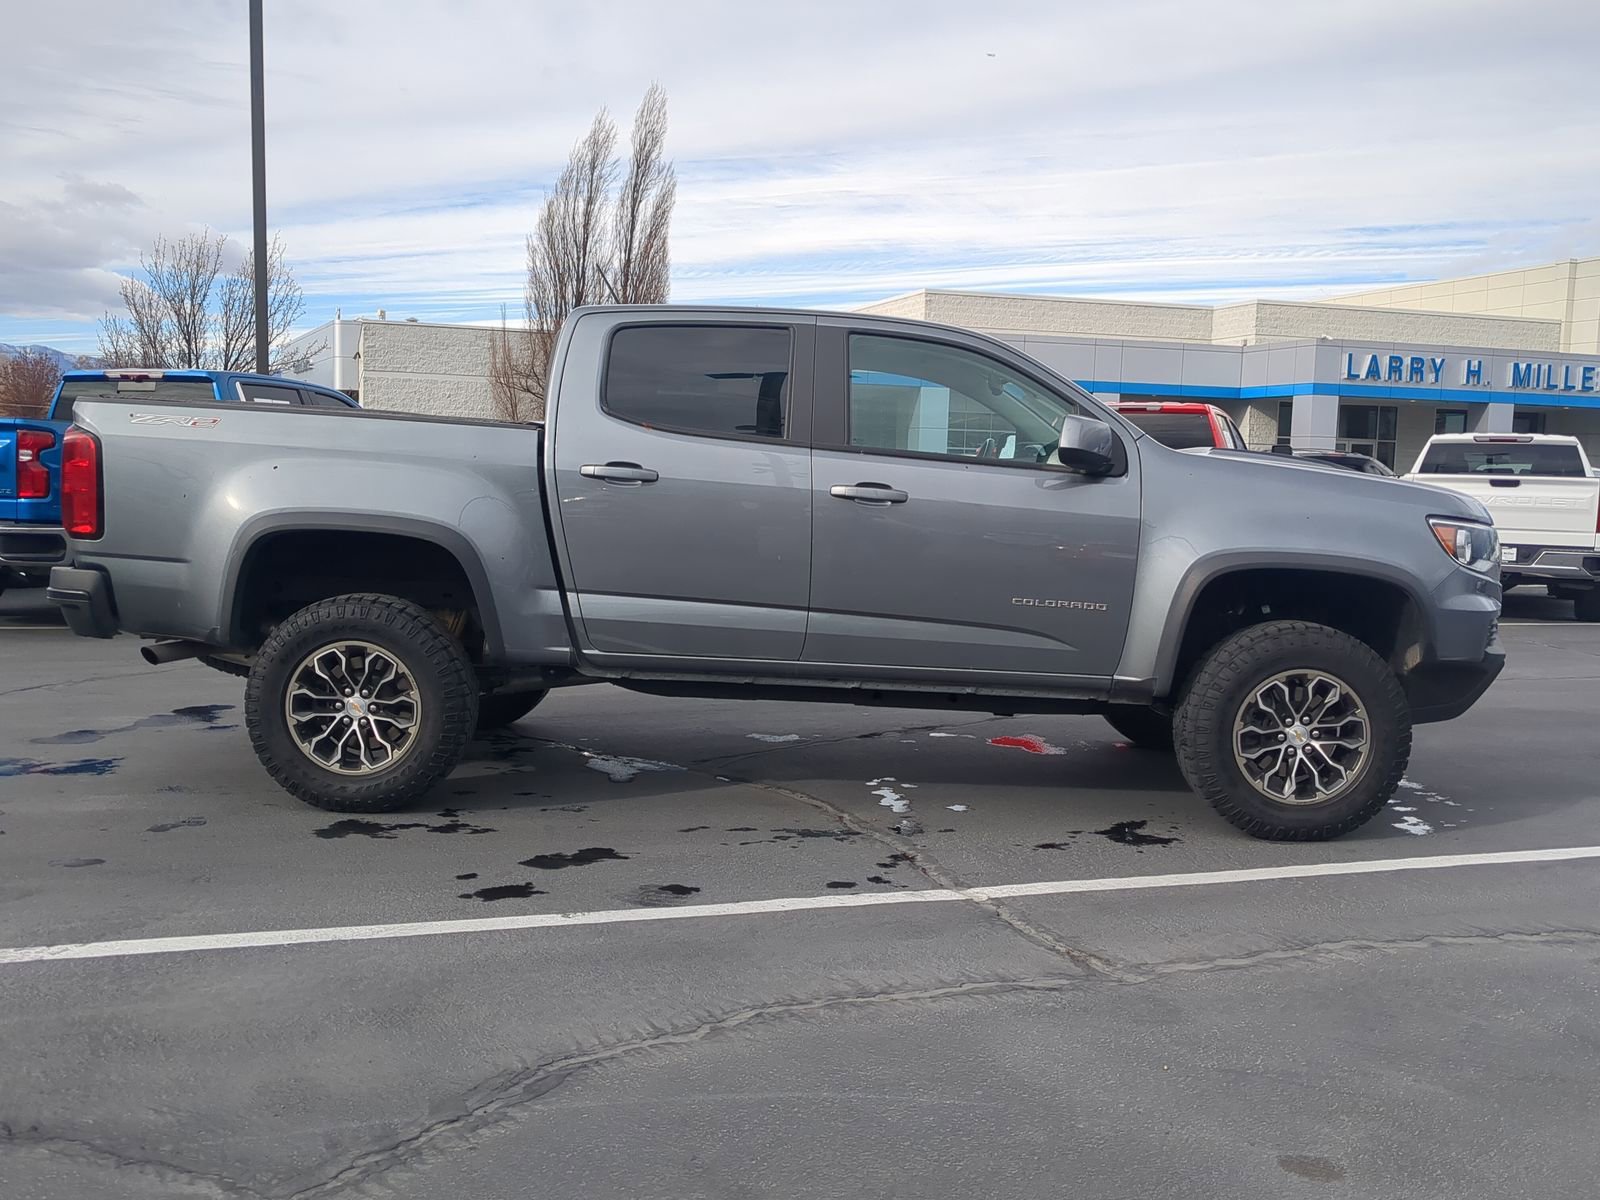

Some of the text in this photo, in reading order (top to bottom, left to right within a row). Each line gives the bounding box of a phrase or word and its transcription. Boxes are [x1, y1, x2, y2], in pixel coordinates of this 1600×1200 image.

[1344, 352, 1600, 392] LARRY H. MILLE
[130, 413, 224, 428] ZR2
[1474, 494, 1587, 507] VROLET
[1011, 597, 1108, 611] COLORADO
